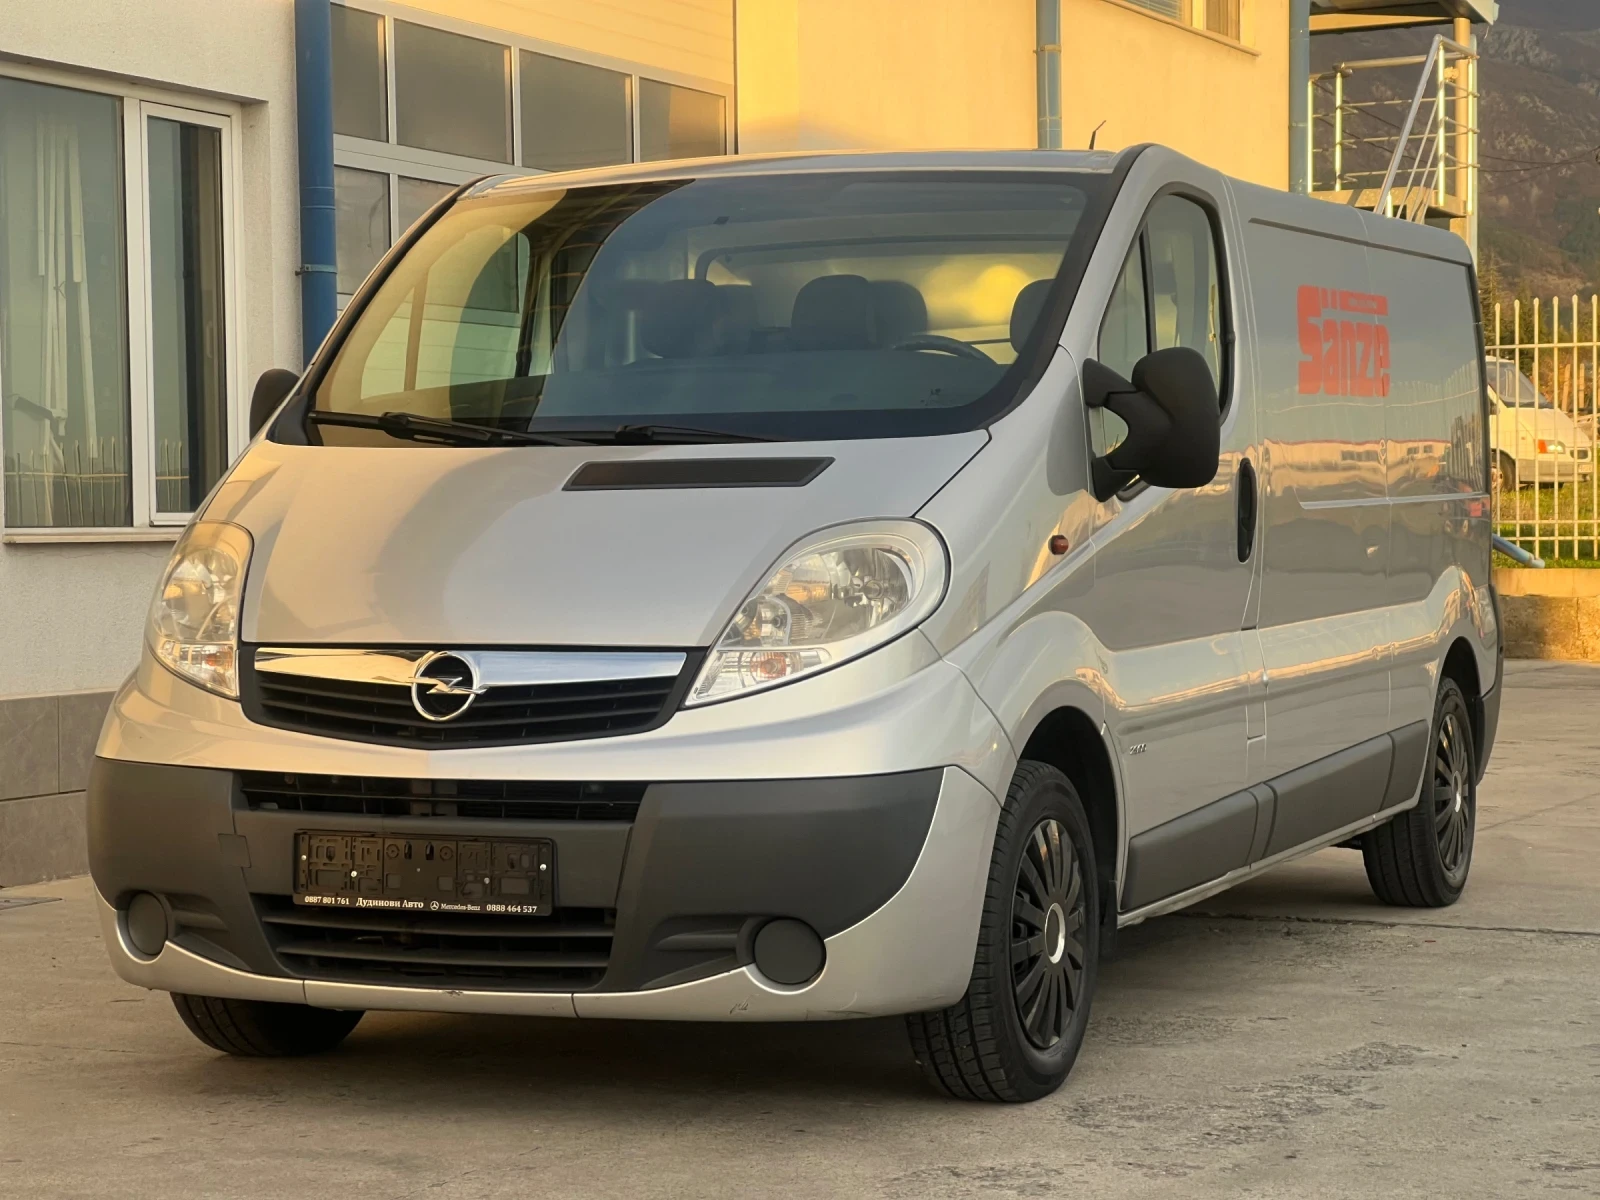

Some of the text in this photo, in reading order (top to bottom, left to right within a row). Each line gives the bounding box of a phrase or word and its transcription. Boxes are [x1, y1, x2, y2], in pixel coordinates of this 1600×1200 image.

[356, 898, 400, 908] Дудинови
[402, 900, 424, 908] Авто
[440, 903, 480, 911] Mercedes-Benz
[486, 904, 505, 912] 0888
[507, 904, 520, 912] 464
[522, 906, 538, 914] 537
